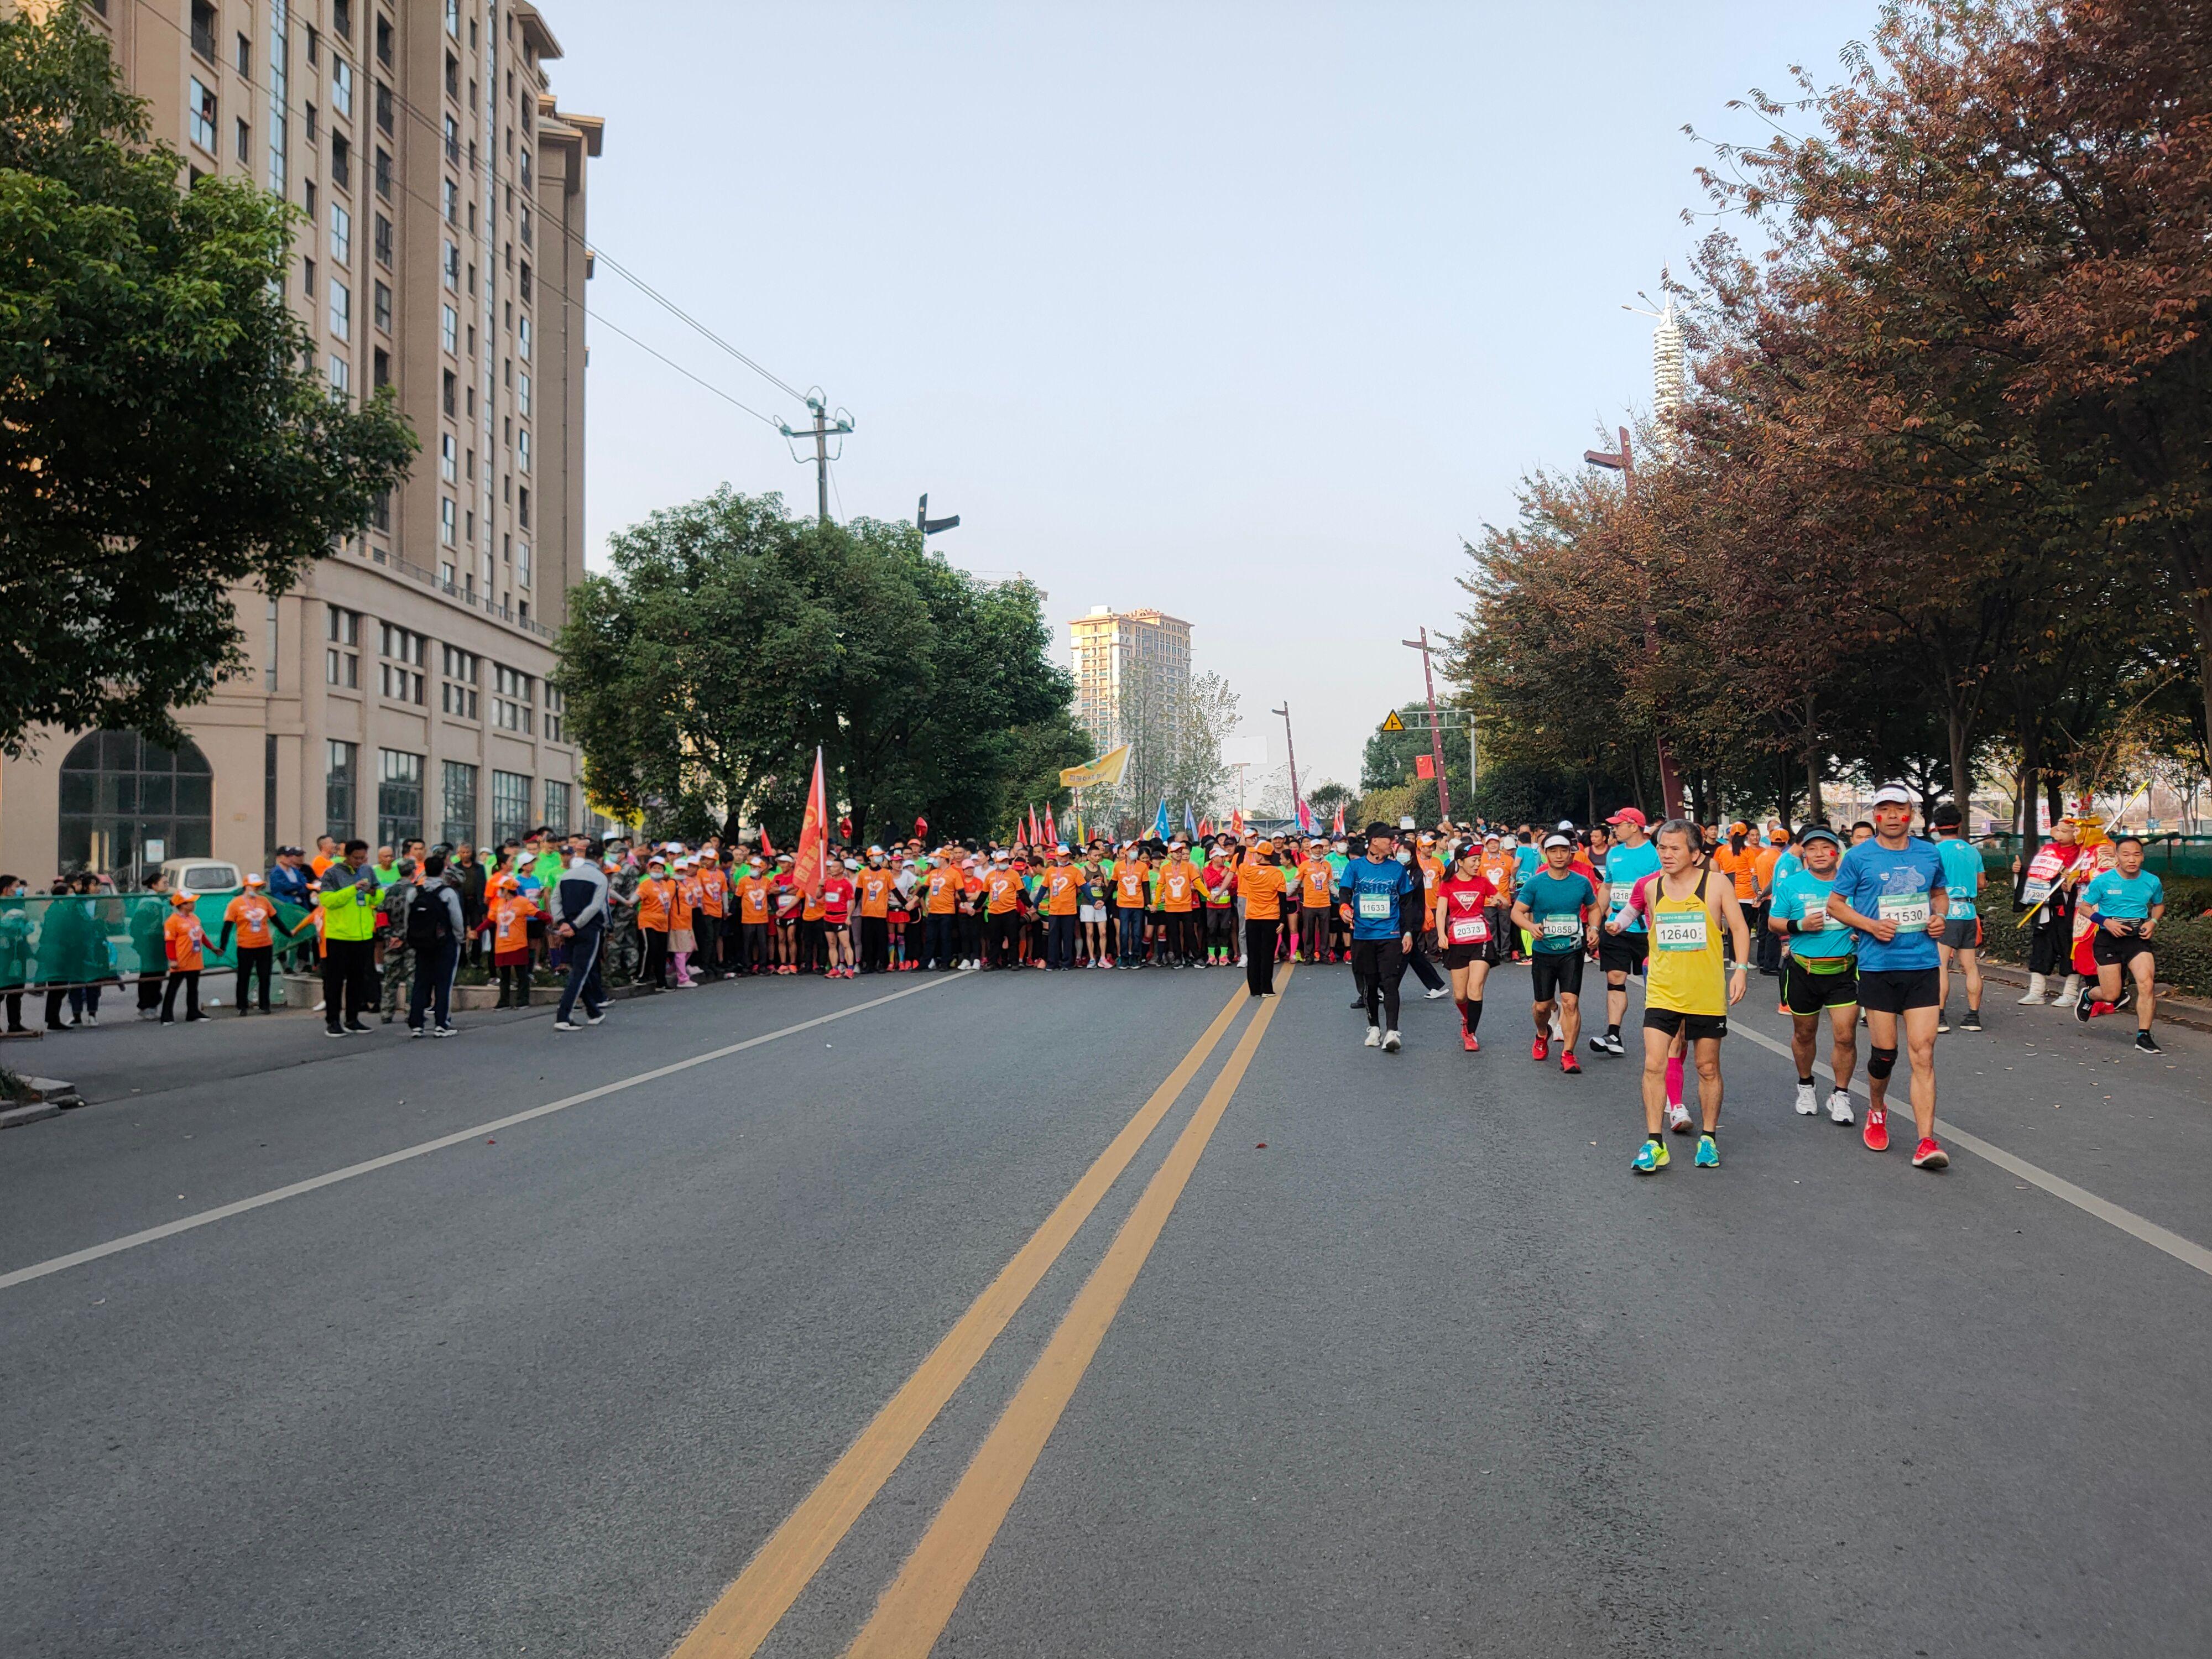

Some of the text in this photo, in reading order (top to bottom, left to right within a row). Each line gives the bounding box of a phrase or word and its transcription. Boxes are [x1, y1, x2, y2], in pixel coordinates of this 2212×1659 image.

[1886, 910, 1923, 923] 11530
[1457, 926, 1481, 936] 20373
[1661, 928, 1697, 940] 12640
